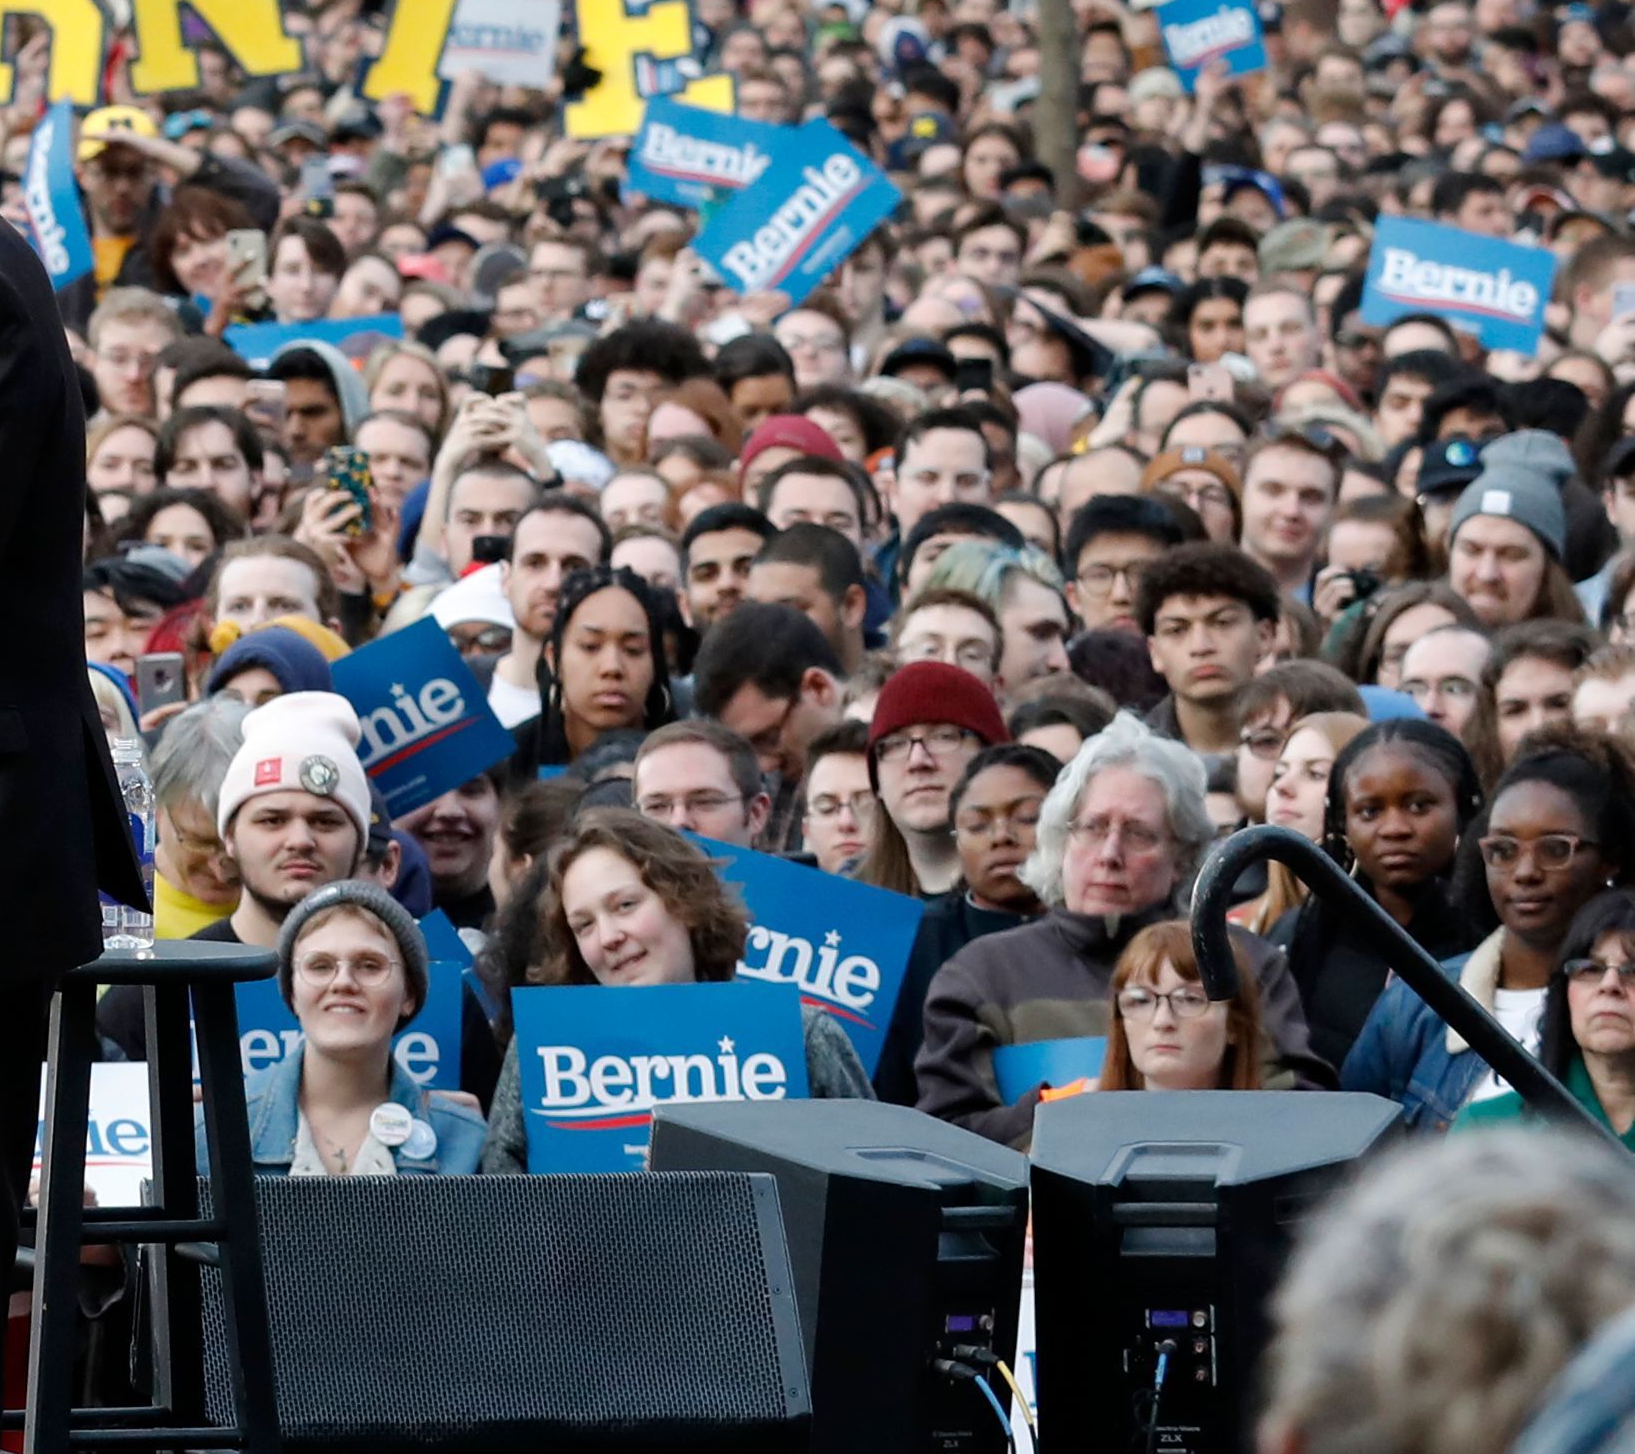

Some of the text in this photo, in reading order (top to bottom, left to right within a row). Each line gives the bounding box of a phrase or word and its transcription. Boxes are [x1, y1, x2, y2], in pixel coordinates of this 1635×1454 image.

[451, 23, 545, 53] ernie
[722, 151, 863, 289] Bernie
[1382, 247, 1539, 317] Bernie
[359, 677, 466, 759] nie
[736, 925, 881, 1016] rnie
[537, 1035, 786, 1106] Bernie
[1160, 1434, 1183, 1443] ZLX
